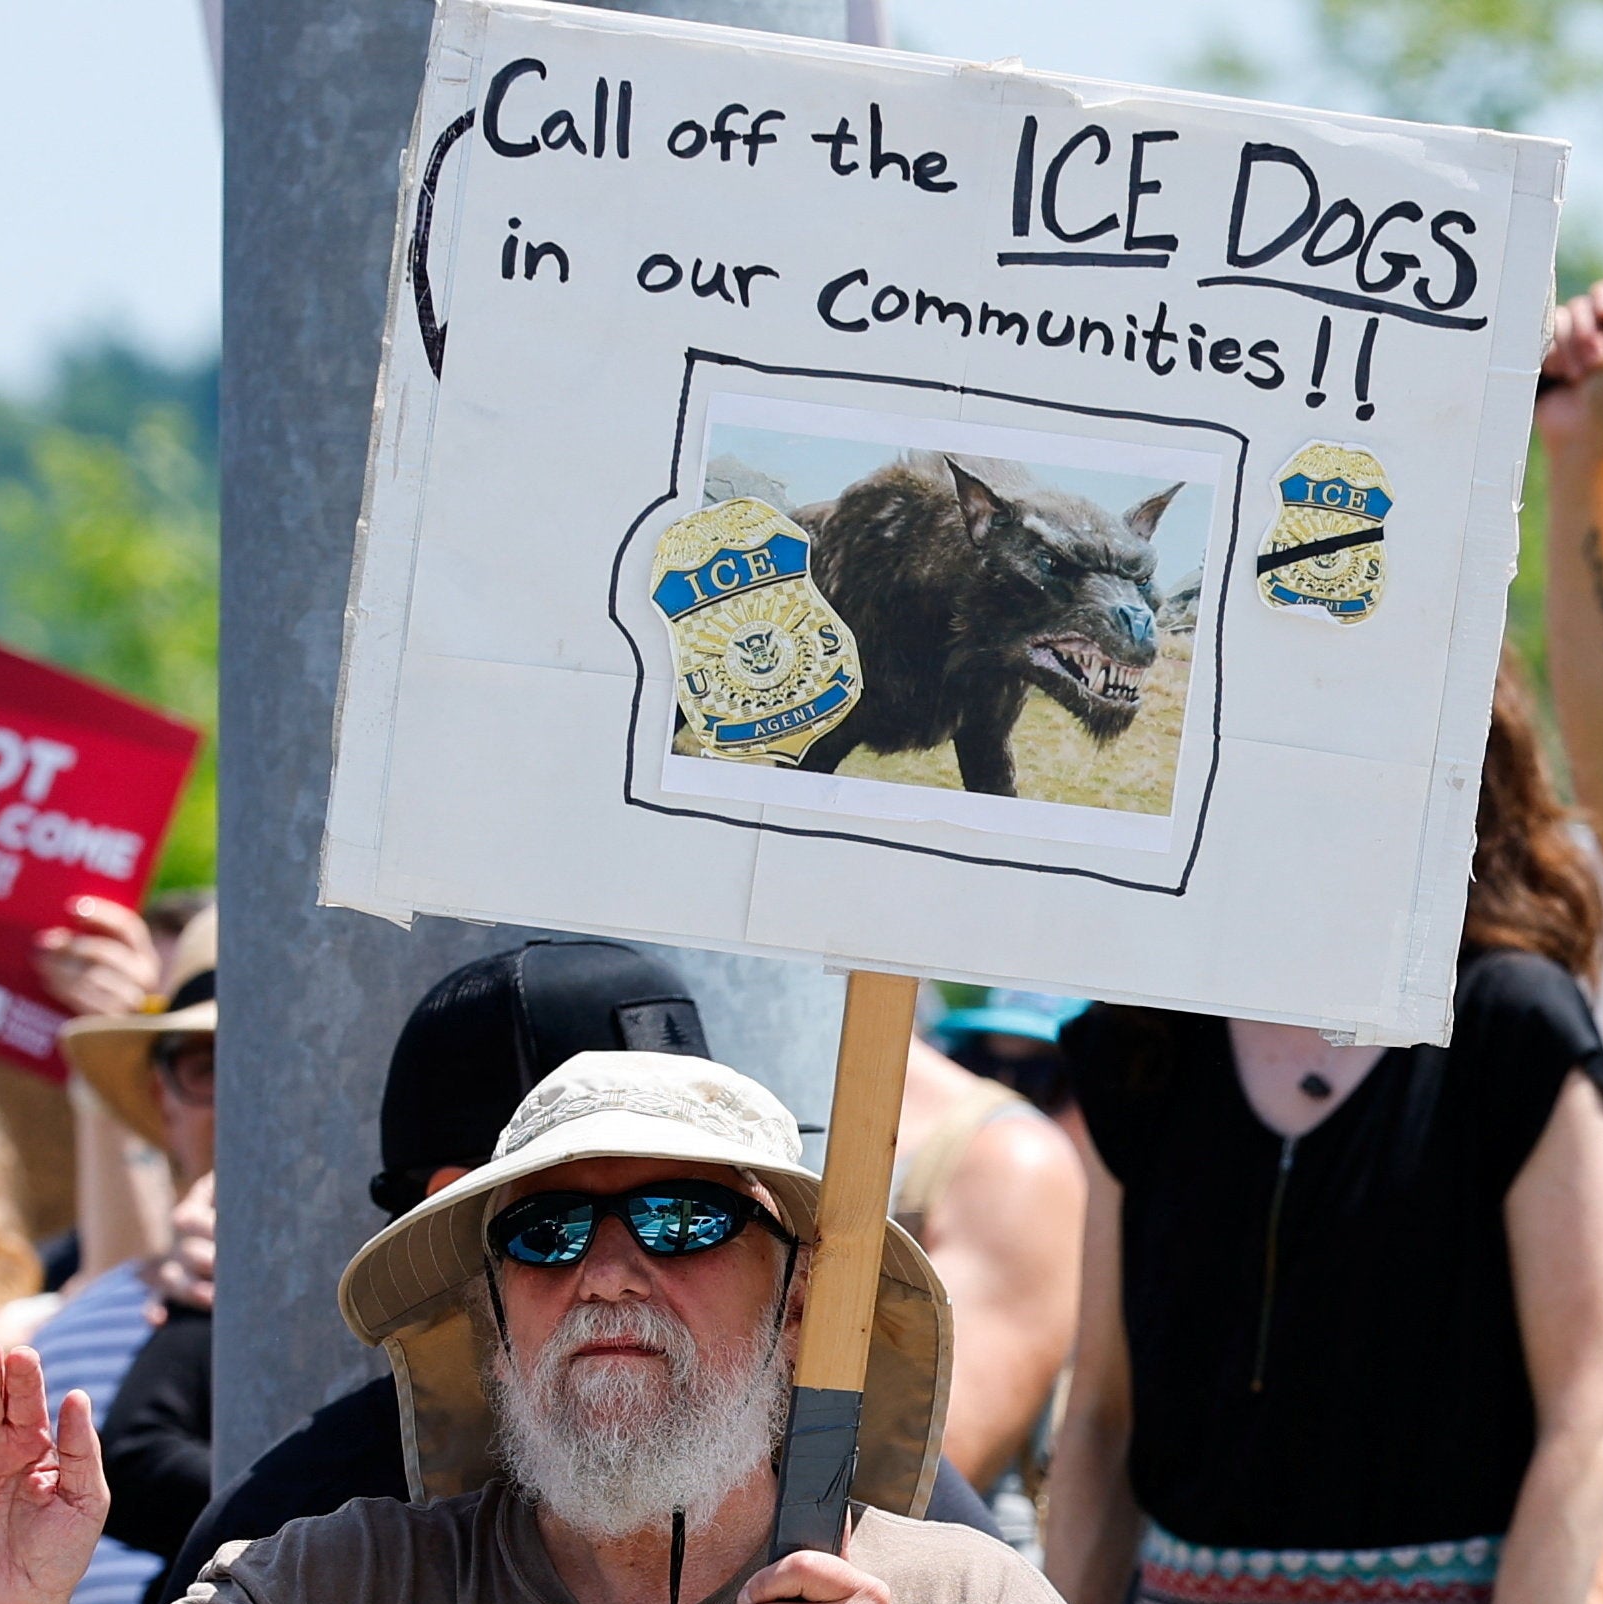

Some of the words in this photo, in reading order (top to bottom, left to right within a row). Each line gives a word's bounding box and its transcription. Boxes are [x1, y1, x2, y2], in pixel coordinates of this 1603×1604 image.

[484, 57, 632, 159] Call
[668, 101, 786, 164] off
[811, 101, 958, 192] the
[1012, 114, 1179, 251] ICE
[502, 217, 571, 284] in
[637, 252, 779, 313] our
[1303, 481, 1368, 512] ICE
[684, 547, 777, 604] ICE
[754, 703, 819, 736] AGENT
